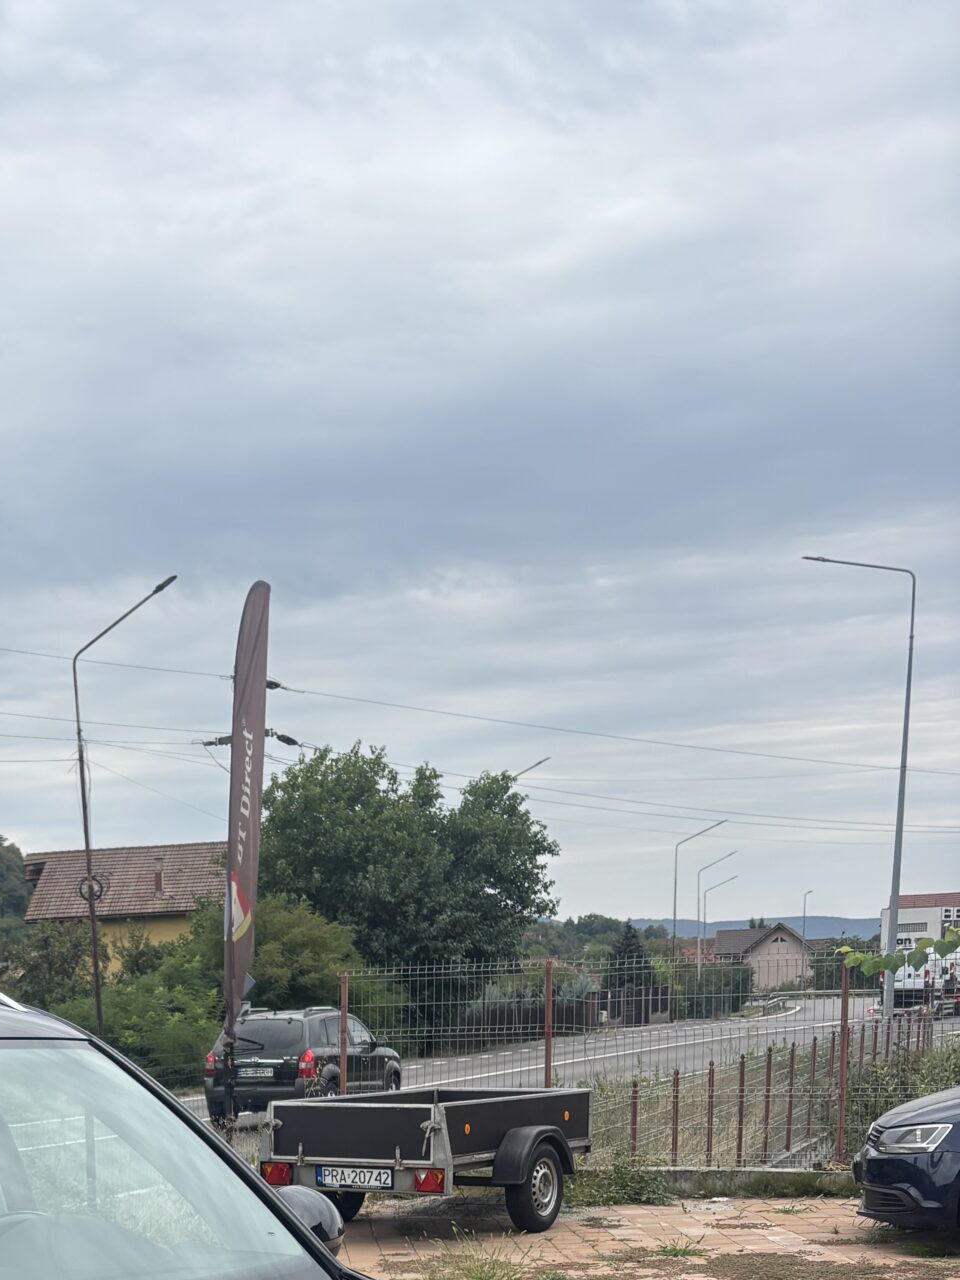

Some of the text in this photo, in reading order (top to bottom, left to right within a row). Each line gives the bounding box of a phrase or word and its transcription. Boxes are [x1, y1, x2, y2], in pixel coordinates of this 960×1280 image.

[240, 727, 254, 819] Direct
[323, 1168, 347, 1184] PRA
[351, 1169, 390, 1186] 20742
